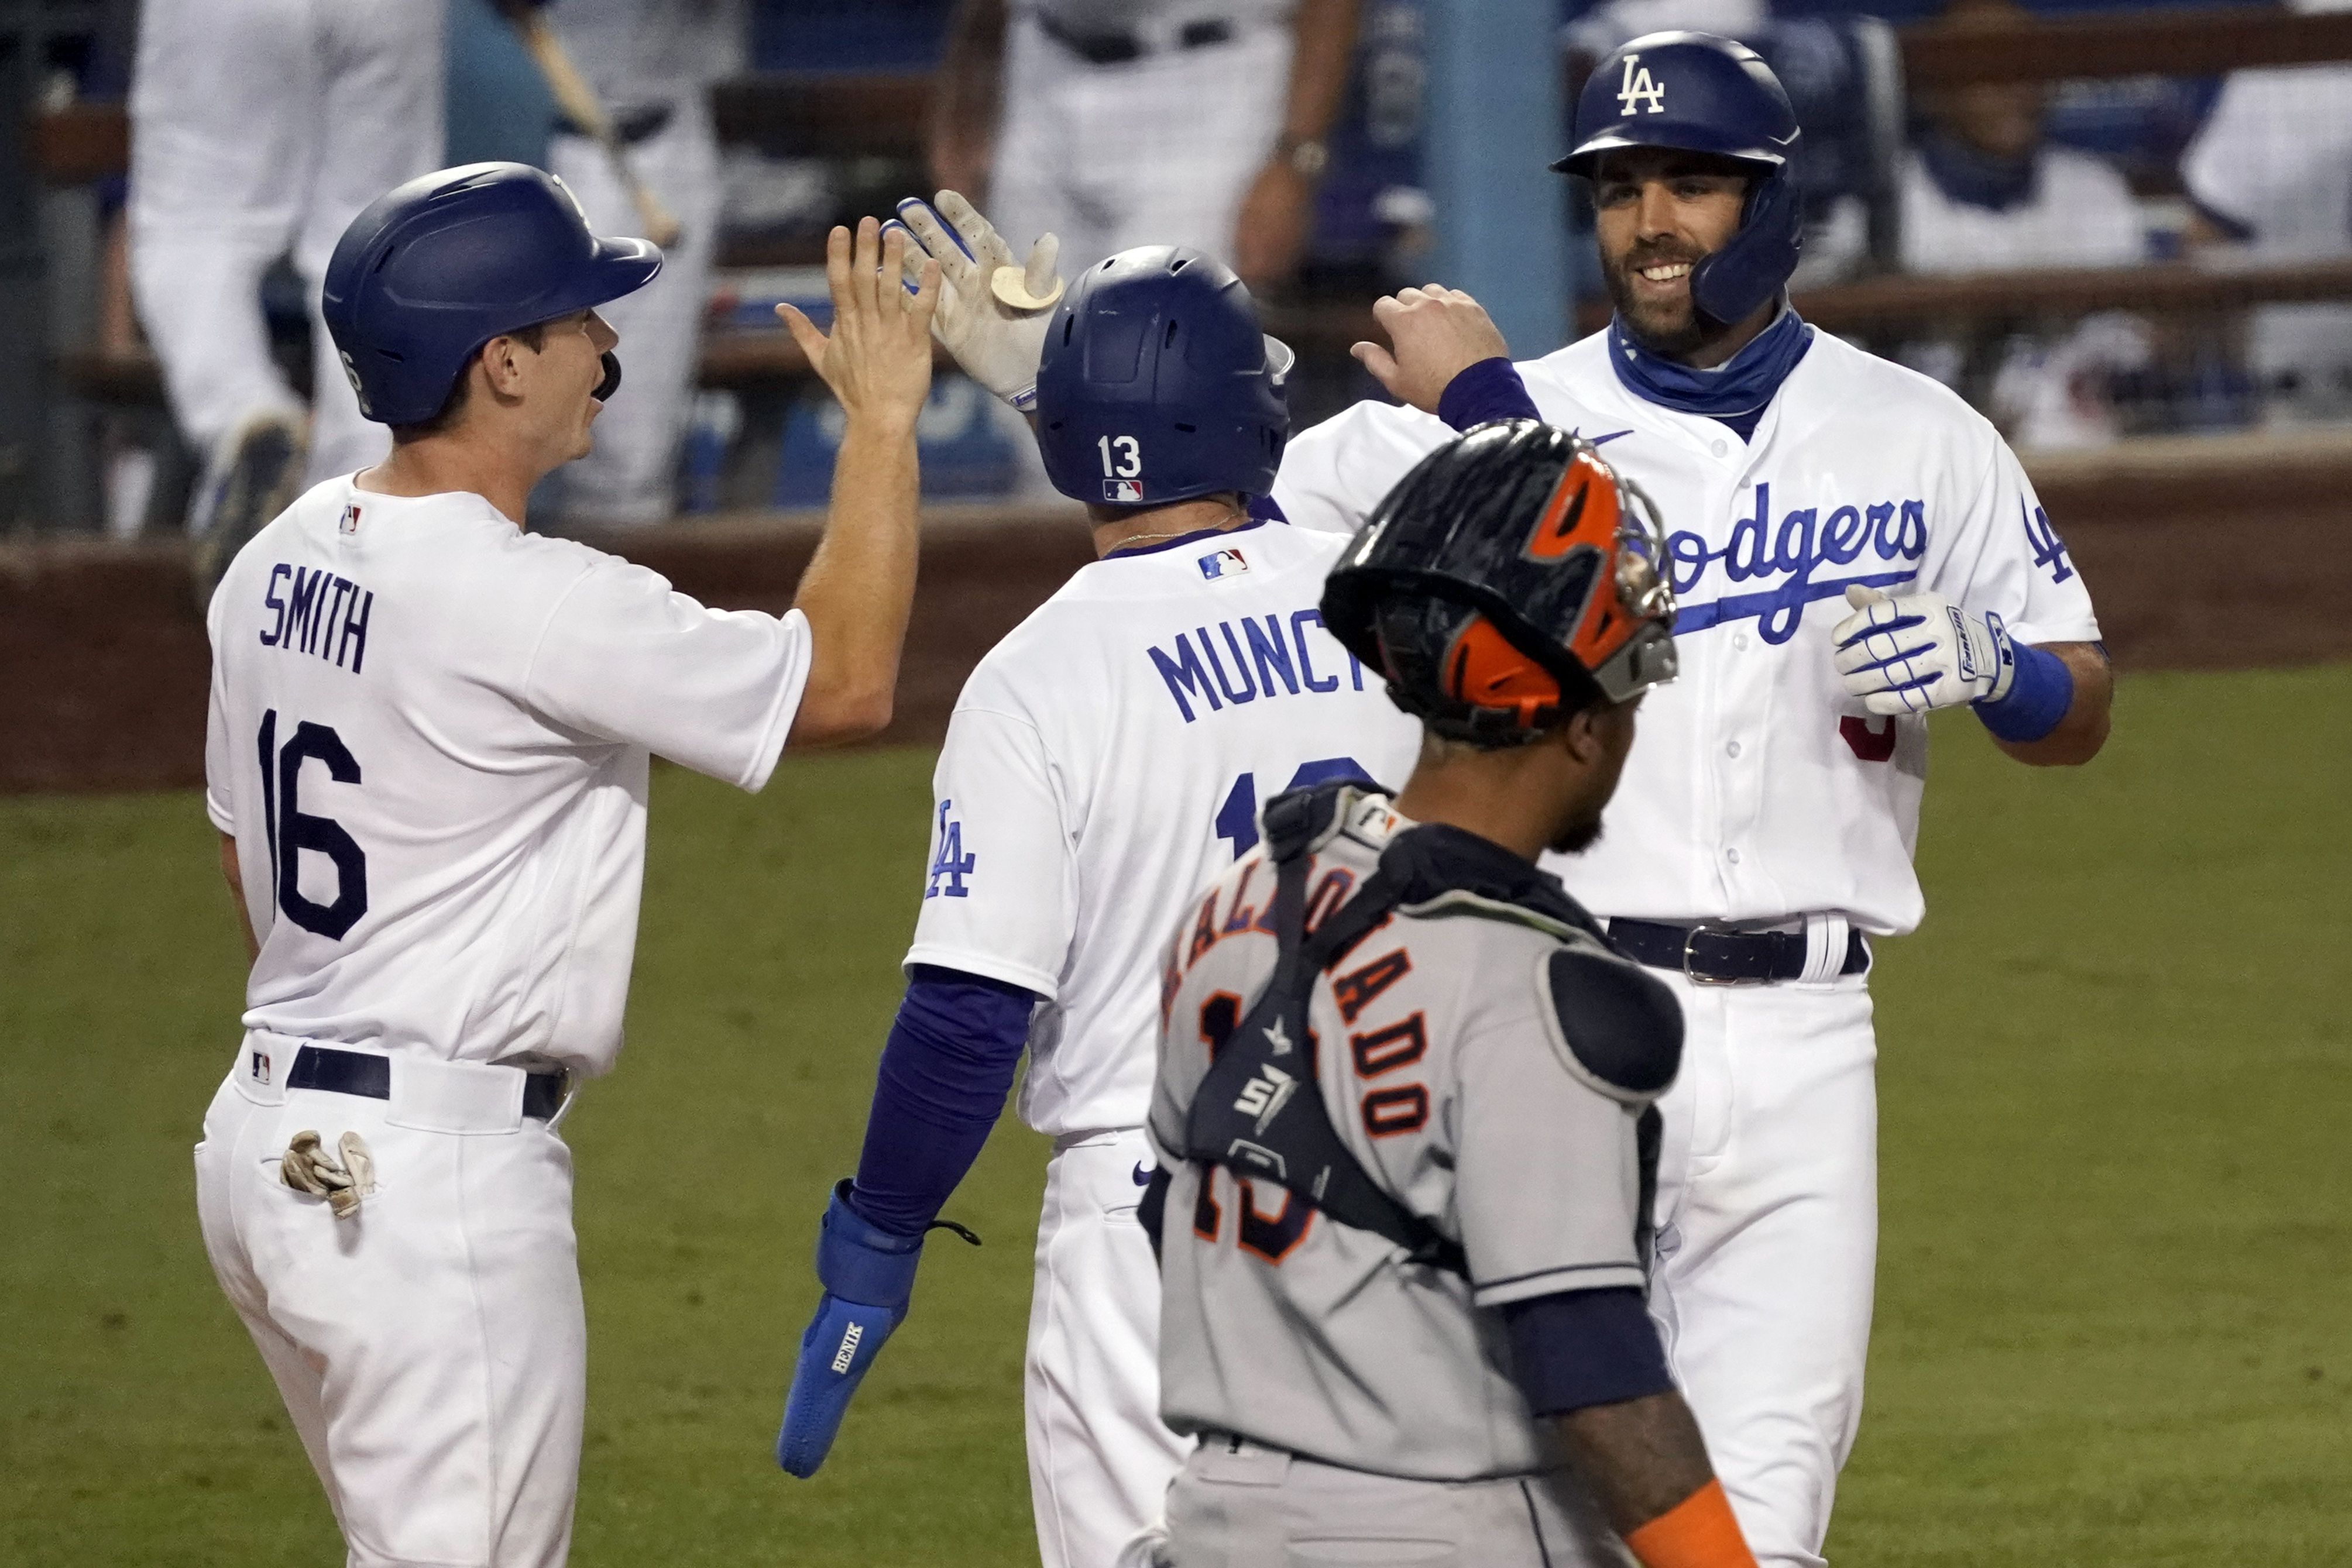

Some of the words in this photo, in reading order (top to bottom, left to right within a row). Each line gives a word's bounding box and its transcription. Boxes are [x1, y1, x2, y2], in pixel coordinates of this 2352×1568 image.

[1618, 54, 1664, 115] LA
[1097, 435, 1142, 478] 13
[1619, 482, 1927, 645] odgers
[259, 563, 374, 674] SMITH
[1952, 610, 1976, 676] Franklin
[257, 709, 368, 941] 16
[925, 799, 976, 899] LA
[831, 1321, 864, 1376] BENIK
